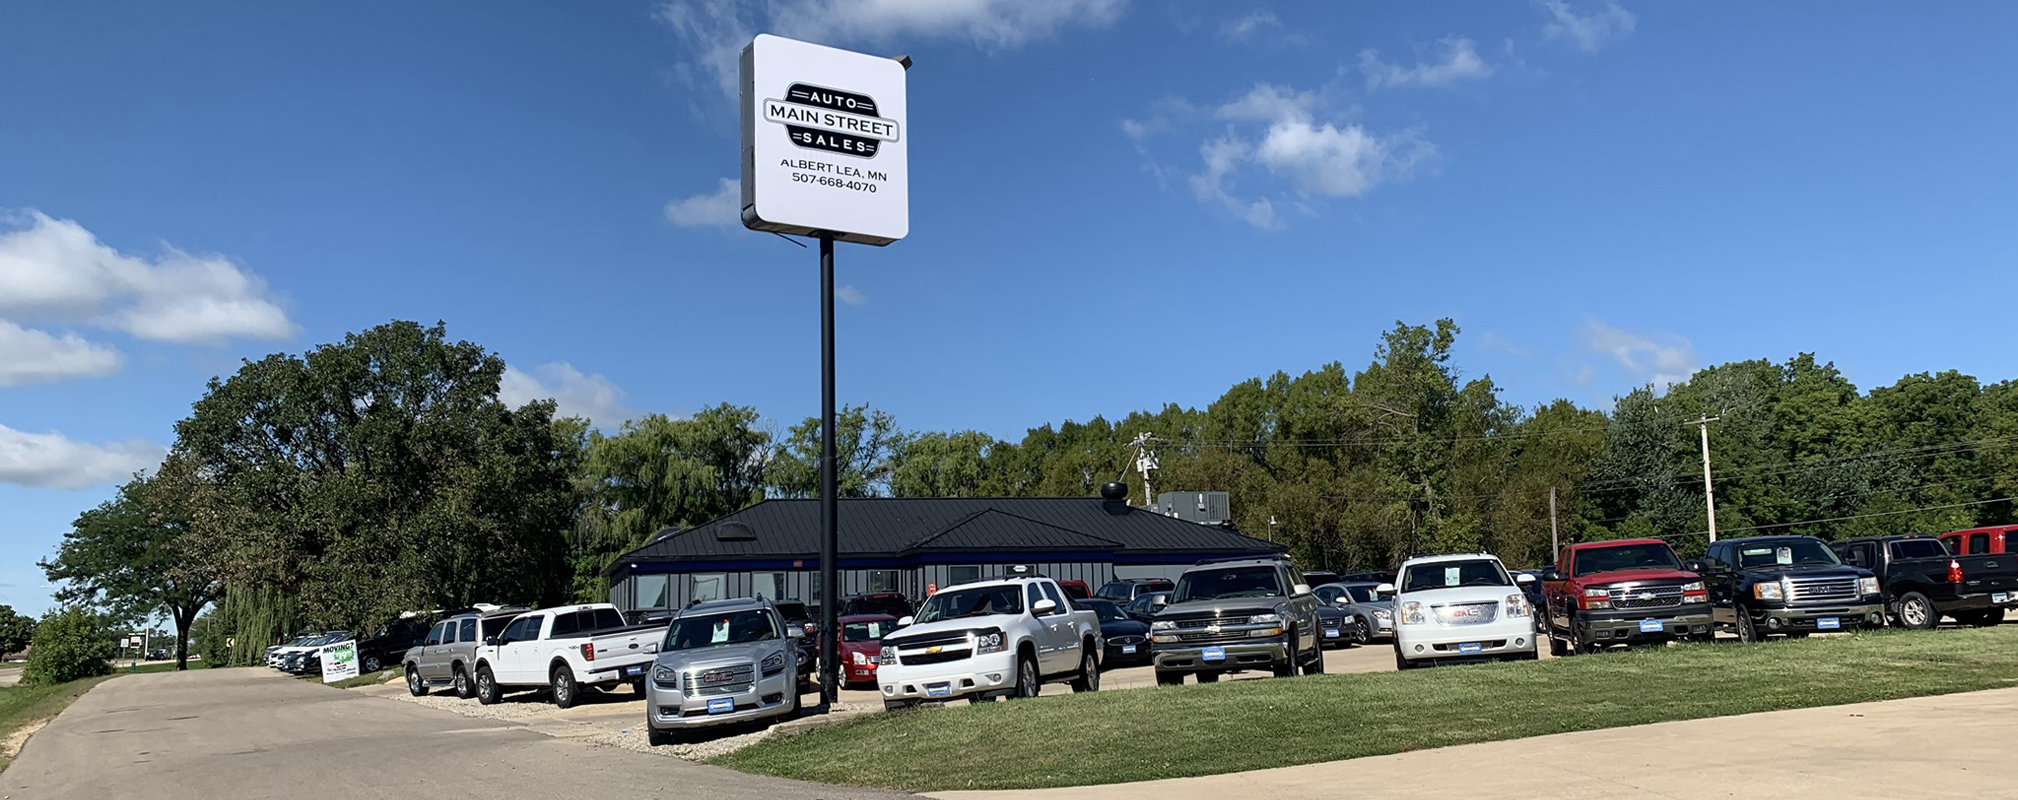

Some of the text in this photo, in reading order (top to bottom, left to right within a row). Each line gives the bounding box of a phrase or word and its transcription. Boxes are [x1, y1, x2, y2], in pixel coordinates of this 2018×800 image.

[810, 91, 857, 109] AUTO
[770, 104, 894, 137] MAIN STREET
[802, 132, 865, 152] SALES
[780, 158, 887, 182] ALBERT LEA, MN
[792, 172, 877, 194] 507-668-4070
[323, 641, 355, 654] MOVING?
